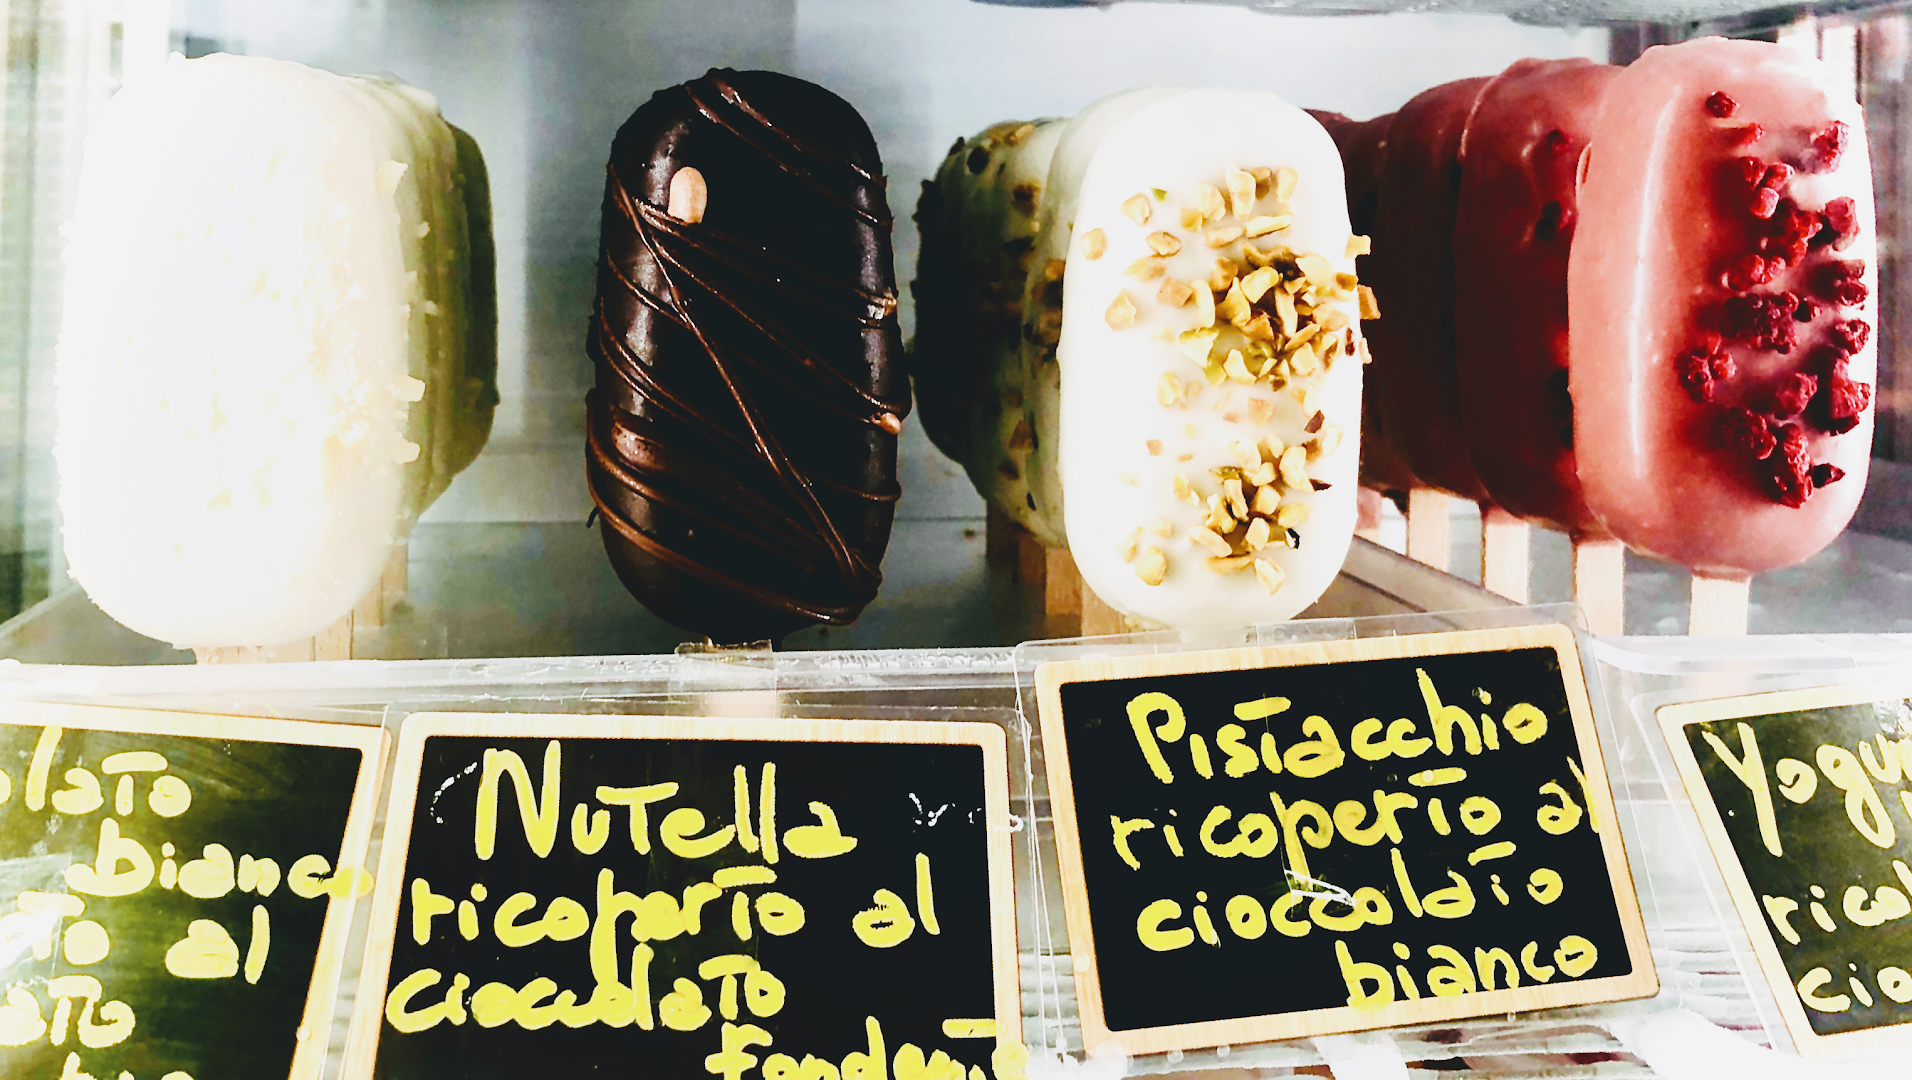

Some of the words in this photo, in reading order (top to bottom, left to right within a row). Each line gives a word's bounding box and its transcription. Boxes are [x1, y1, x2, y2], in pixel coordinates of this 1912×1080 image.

[0, 724, 192, 817] lato
[1126, 667, 1548, 784] Pistacchio
[475, 740, 857, 864] Nutella
[1111, 767, 1501, 894] ricoperto
[1537, 756, 1600, 835] al
[165, 904, 270, 985] al
[411, 865, 805, 984] ricoperto
[852, 853, 940, 948] al
[1137, 841, 1564, 951] cioccolato
[386, 942, 786, 1034] cioccolato
[1335, 935, 1598, 1011] bianco
